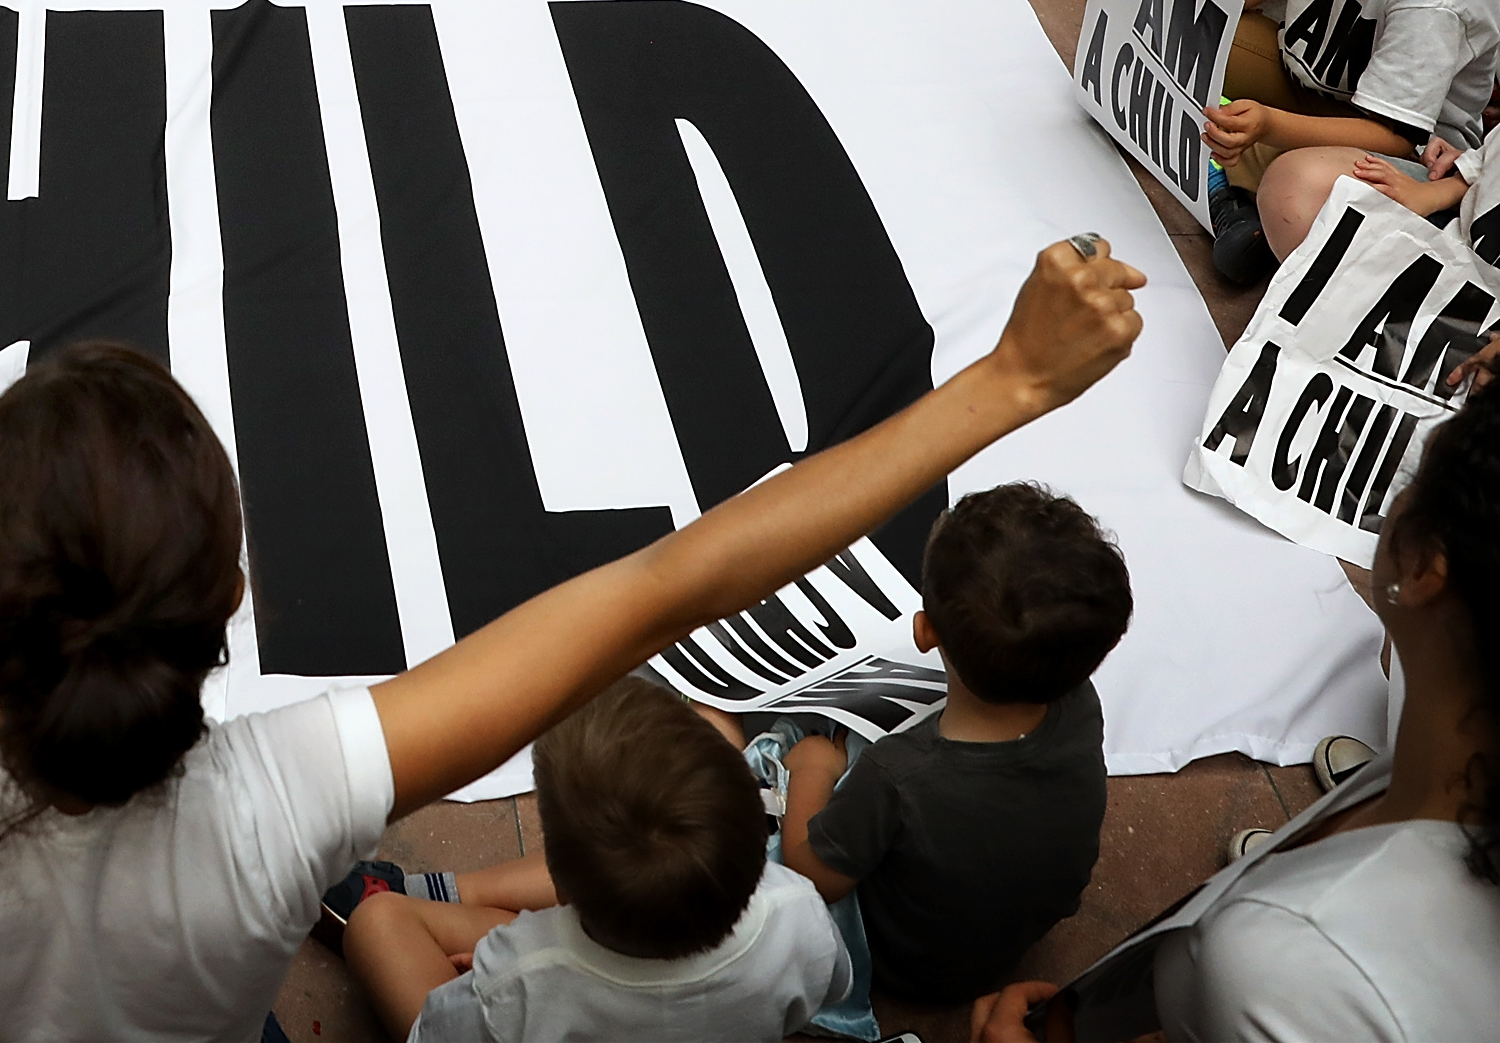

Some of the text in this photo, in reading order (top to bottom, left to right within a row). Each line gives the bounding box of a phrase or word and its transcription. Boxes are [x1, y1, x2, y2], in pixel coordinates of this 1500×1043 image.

[1082, 9, 1201, 202] A CHILD
[1278, 206, 1365, 326] I
[1203, 341, 1419, 534] A CHIL
